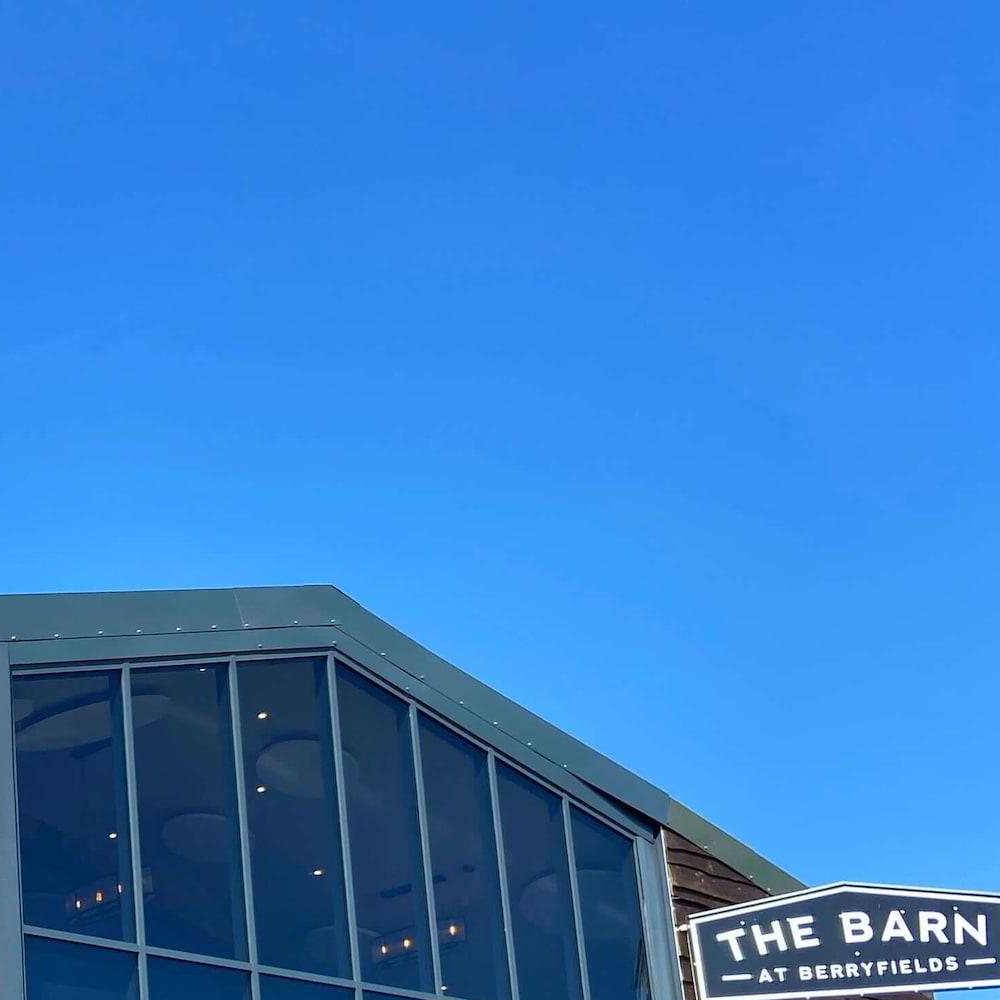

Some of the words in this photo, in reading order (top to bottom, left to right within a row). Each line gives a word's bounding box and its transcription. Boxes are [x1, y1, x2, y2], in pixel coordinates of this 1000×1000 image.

[716, 915, 821, 962] THE
[839, 910, 988, 947] BARN
[758, 967, 790, 984] AT
[798, 956, 960, 981] BERRYFIELDS
